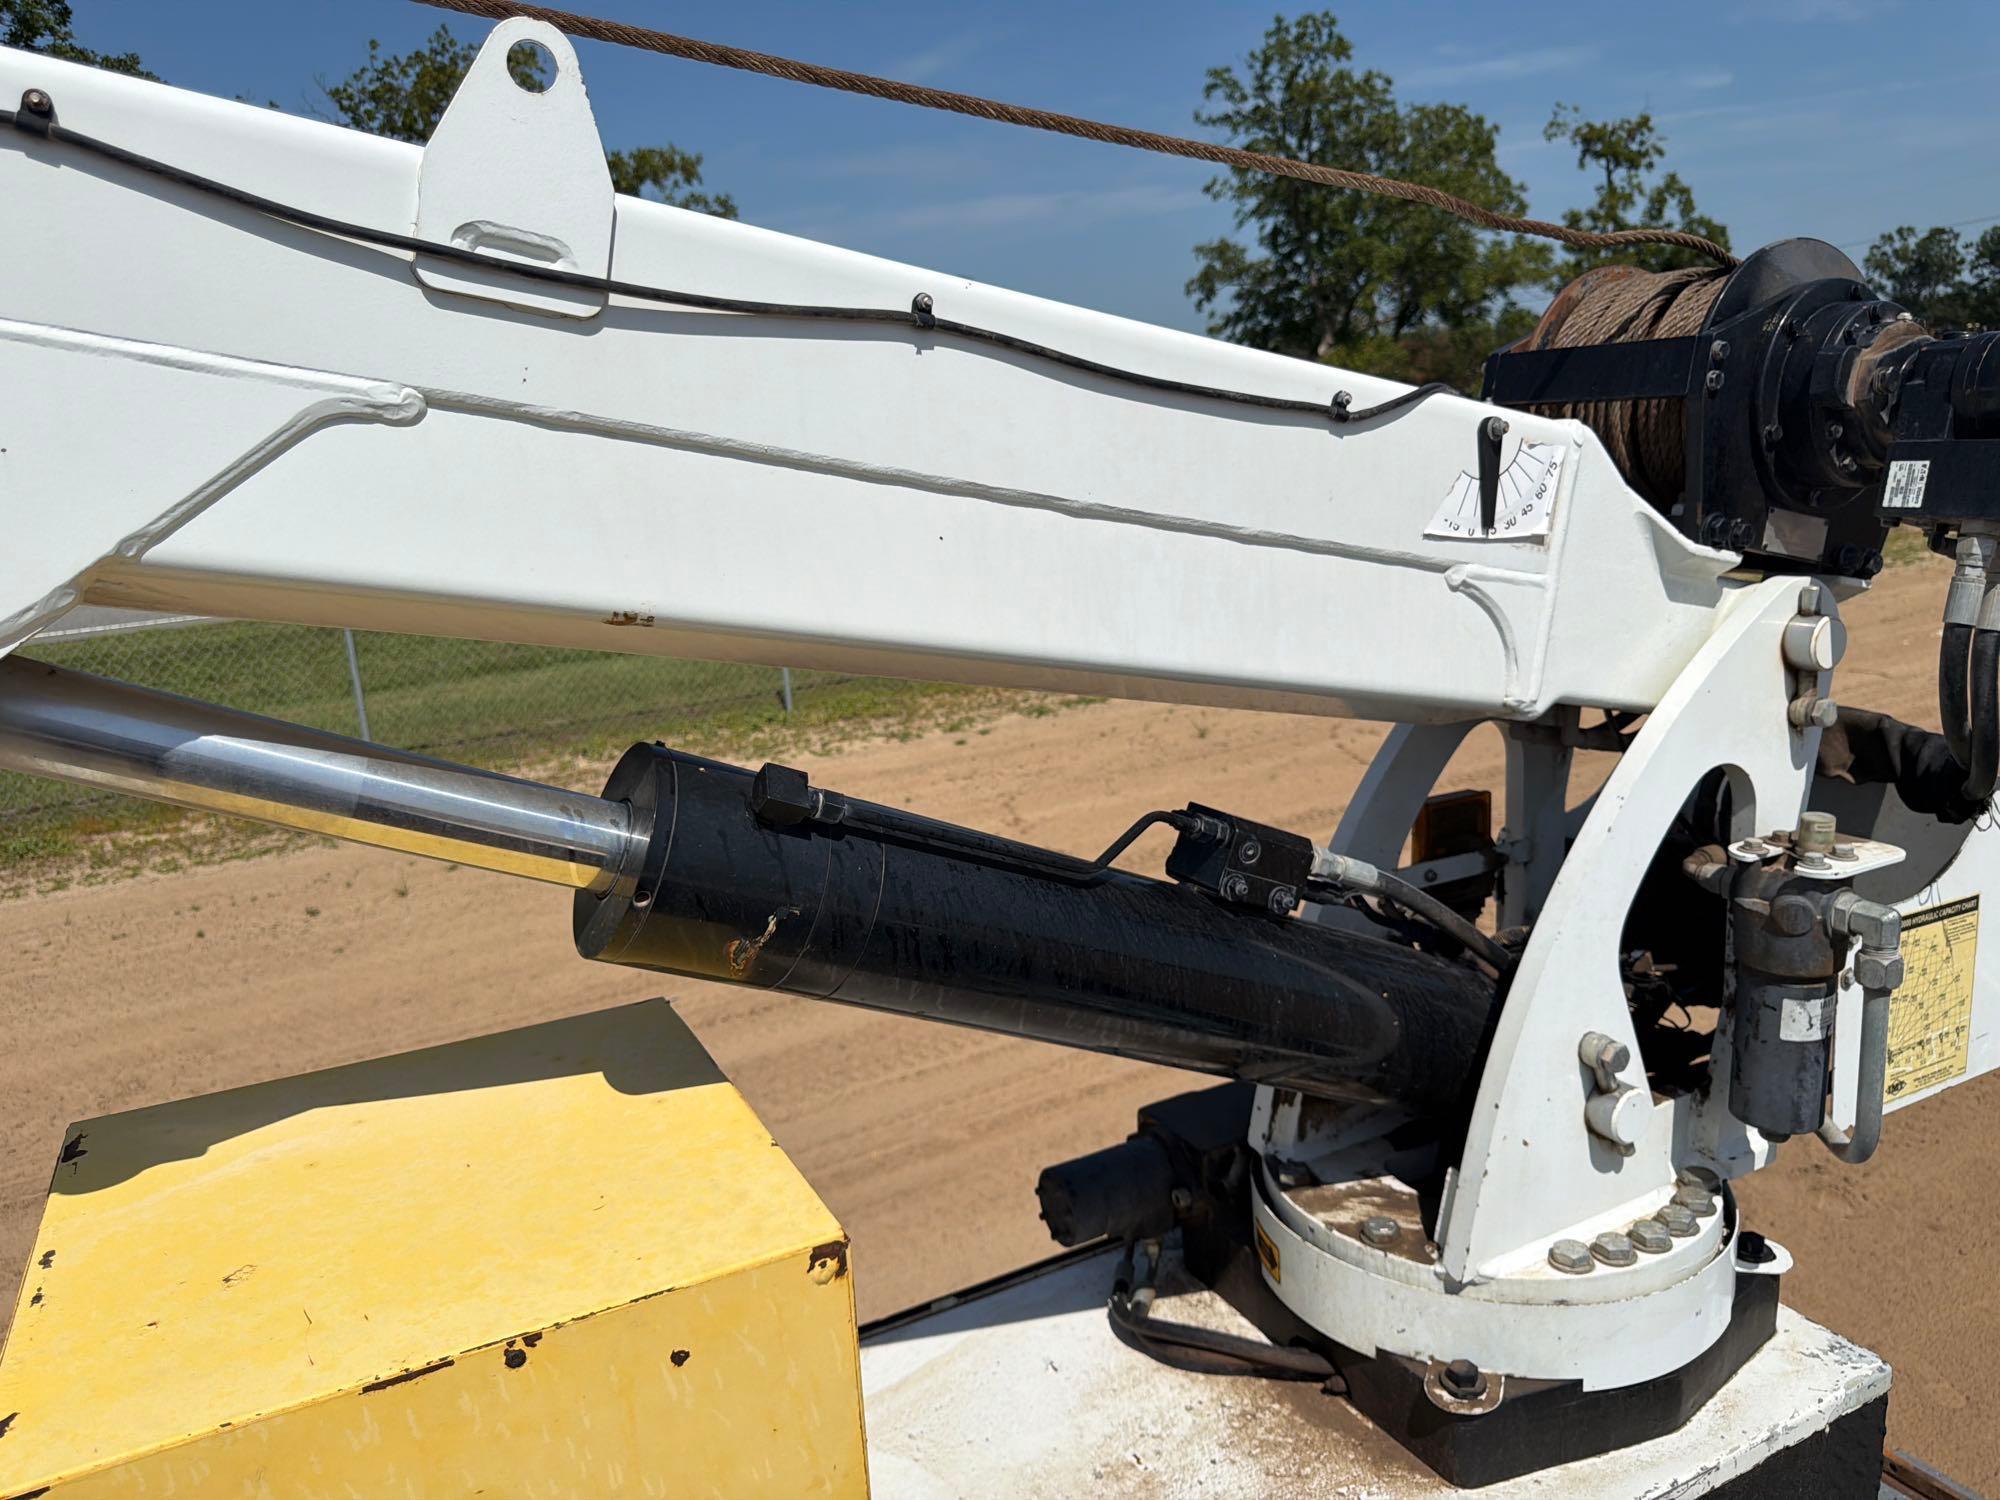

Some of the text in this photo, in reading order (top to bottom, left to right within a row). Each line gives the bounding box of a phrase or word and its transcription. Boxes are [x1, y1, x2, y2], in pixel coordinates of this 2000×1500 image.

[1504, 516, 1517, 530] 30
[1521, 503, 1534, 517] 45
[1535, 483, 1548, 500] 60
[1545, 460, 1558, 478] 75
[1912, 911, 1938, 925] HYDRAULIC
[1938, 905, 1960, 918] CAPACITY
[1962, 899, 1977, 911] CHART
